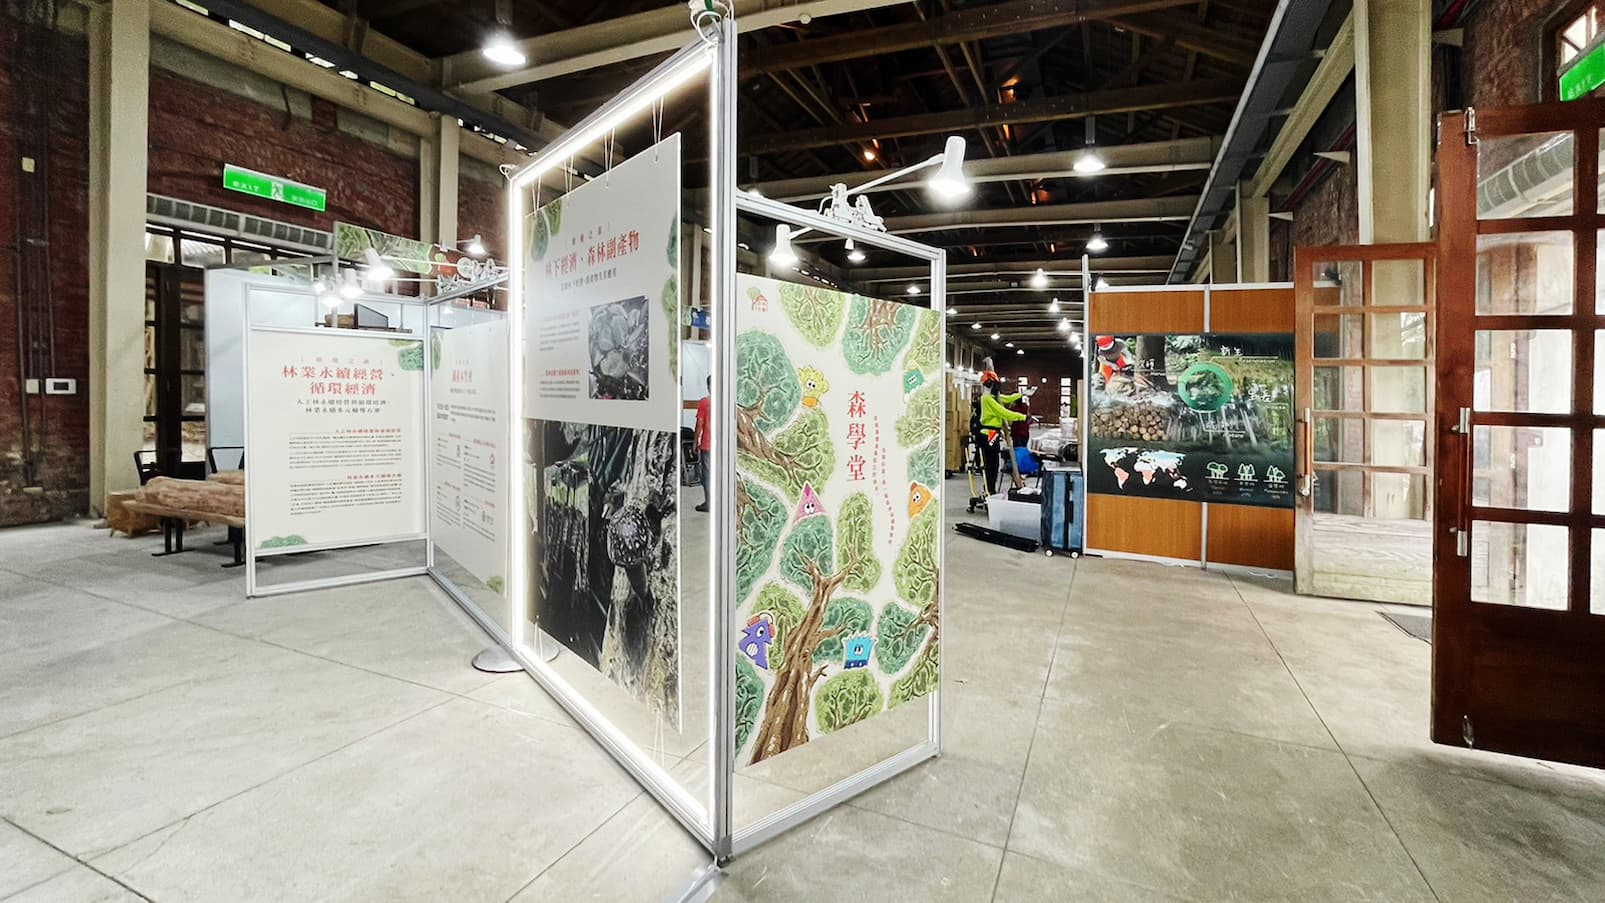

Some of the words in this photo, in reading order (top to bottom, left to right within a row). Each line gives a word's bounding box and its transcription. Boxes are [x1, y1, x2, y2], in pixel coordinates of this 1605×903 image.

[232, 181, 261, 192] EXIT
[310, 382, 376, 396] 循環經濟
[846, 390, 866, 481] 森學堂
